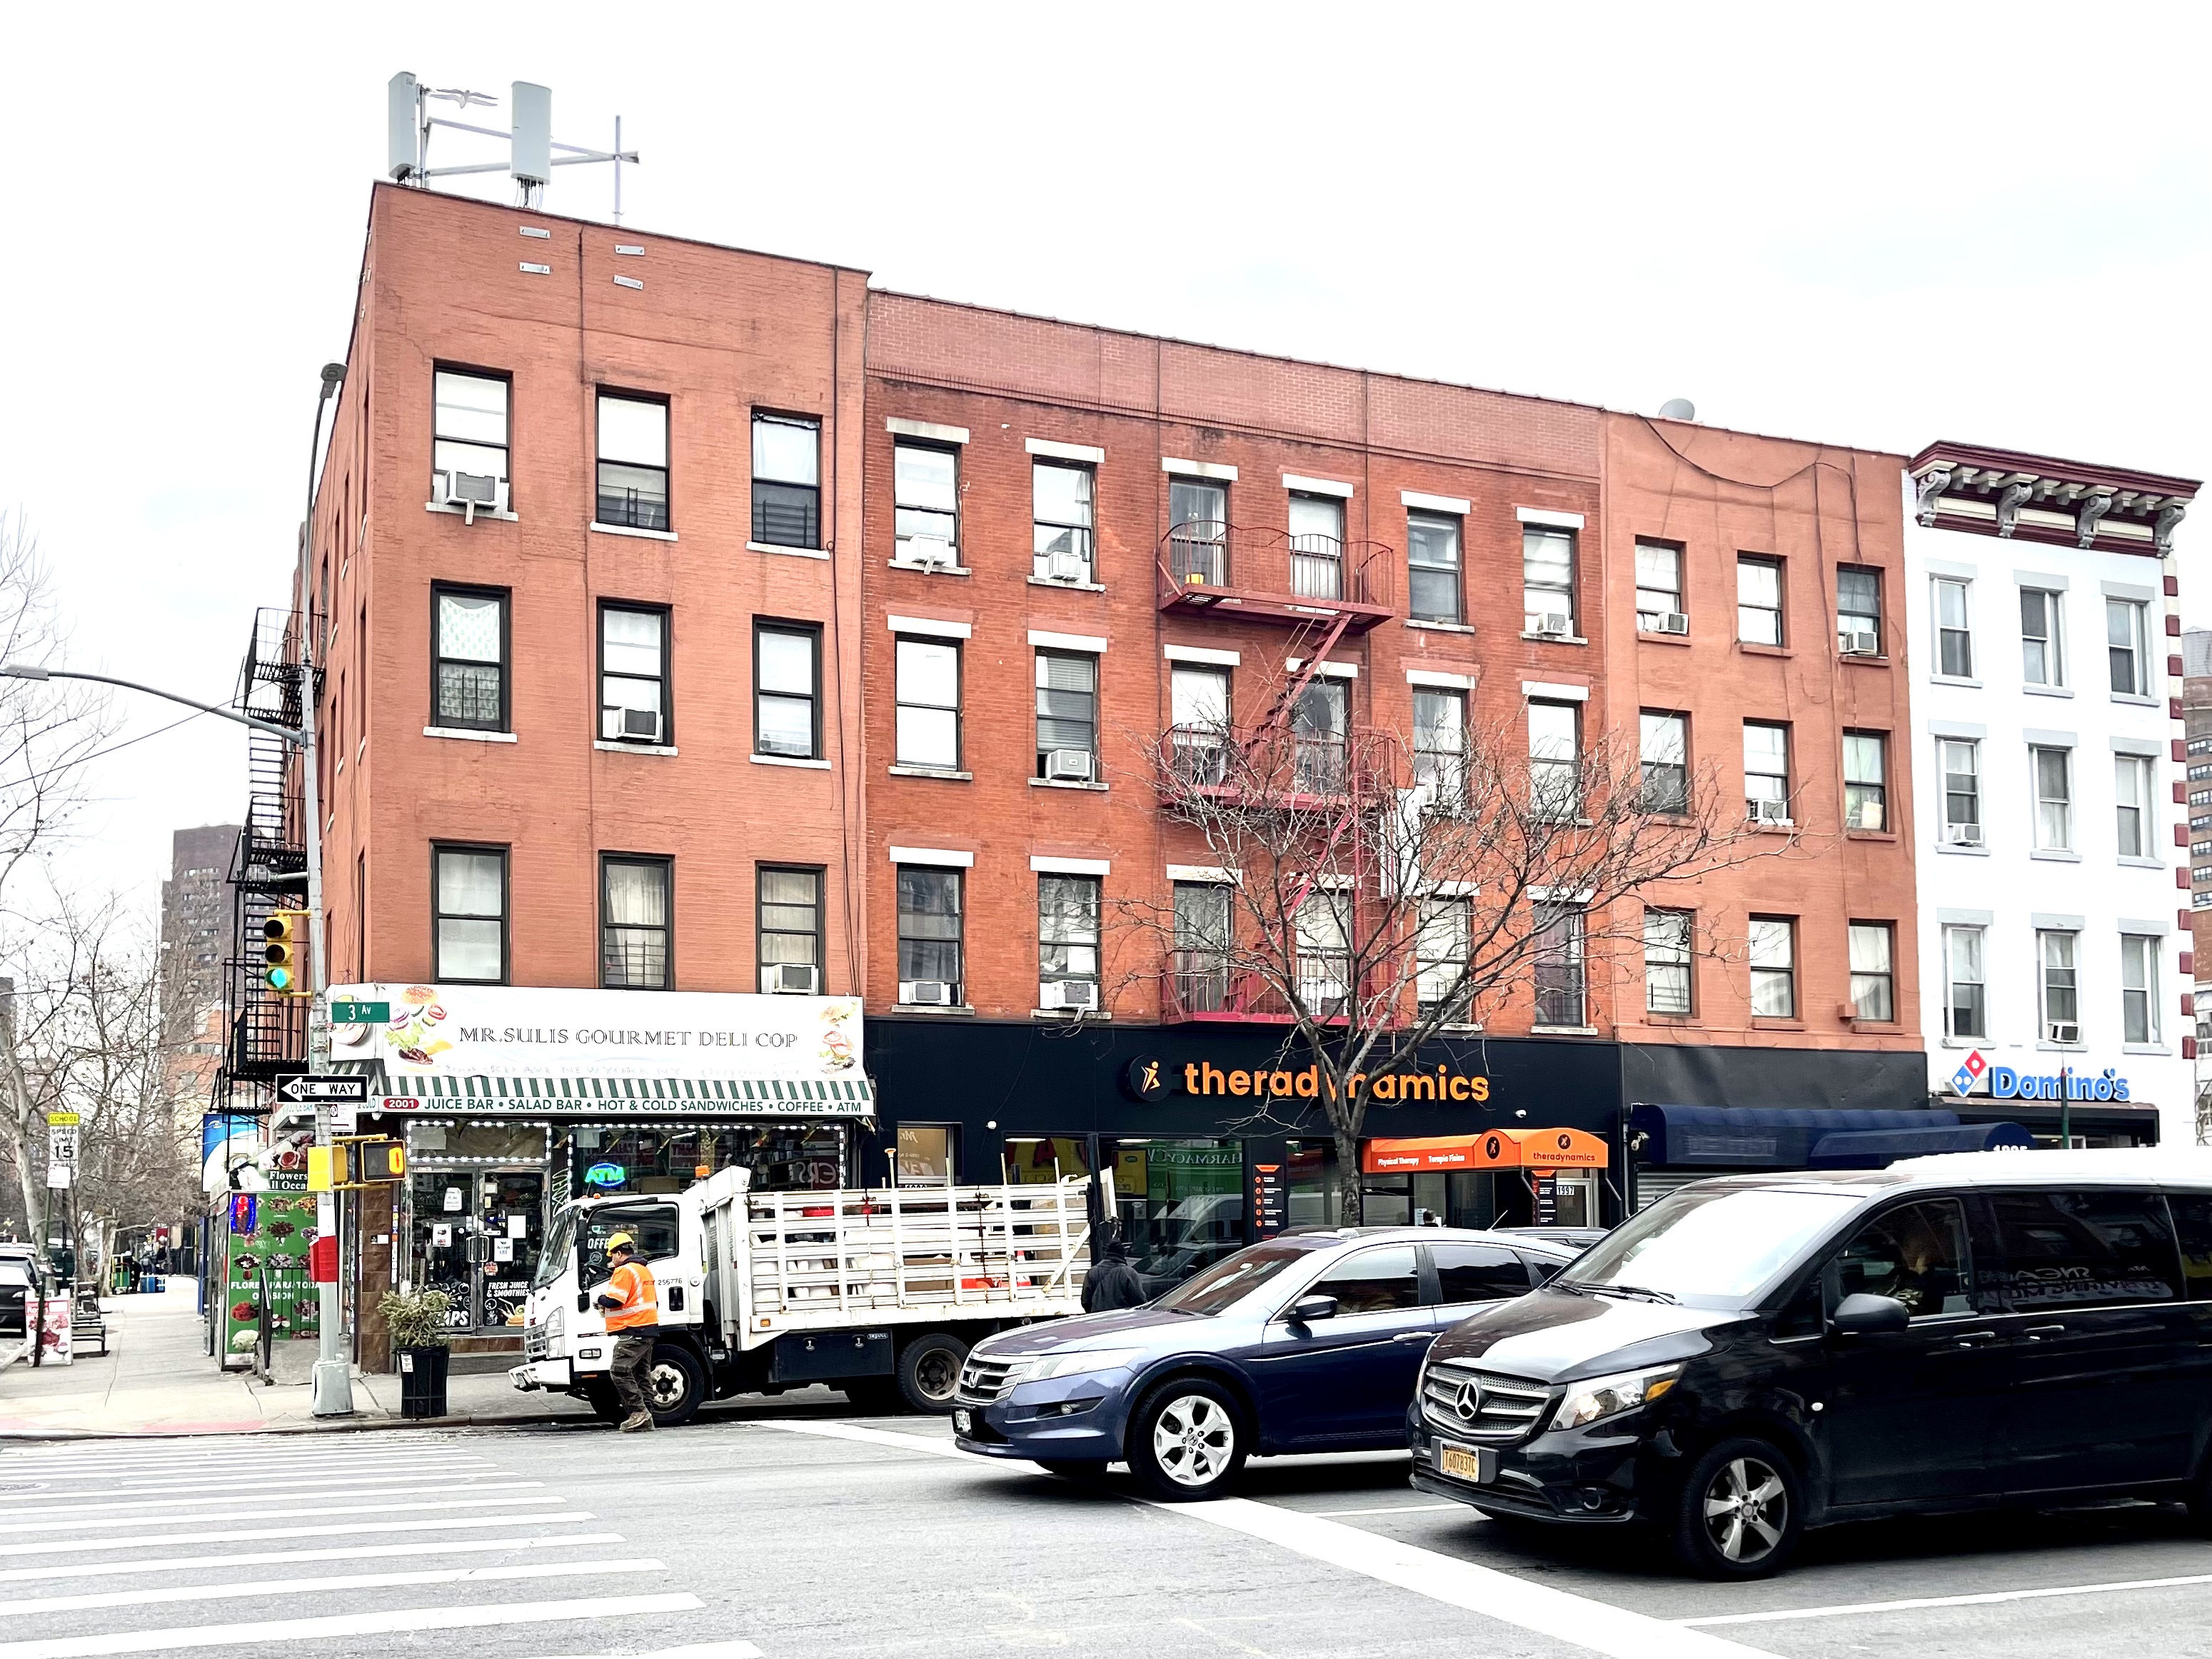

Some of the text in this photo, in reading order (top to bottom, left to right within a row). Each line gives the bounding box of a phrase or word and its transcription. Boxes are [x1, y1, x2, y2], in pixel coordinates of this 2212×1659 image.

[348, 1004, 371, 1021] 3 Av
[459, 1027, 798, 1048] MR.SULIS GOURMET DELI COP
[291, 1083, 356, 1094] ONE WAY
[1990, 1066, 2131, 1102] Domino's
[388, 1098, 861, 1112] 2001 JUICE BAR SALAD BAR HOT & COLD SANDWICHES COFFEE ATM
[54, 1146, 74, 1158] 15
[1533, 1152, 1596, 1163] theradynamics
[1377, 1157, 1419, 1168] Physical Therapy
[269, 1171, 307, 1181] Flowers
[584, 1166, 625, 1183] ATM
[281, 1181, 307, 1190] Occa
[1557, 1186, 1574, 1195] 1997
[230, 1281, 261, 1290] FLORE
[488, 1280, 529, 1290] FRESH JUICE
[251, 1292, 294, 1300] OSION
[486, 1289, 493, 1298] &
